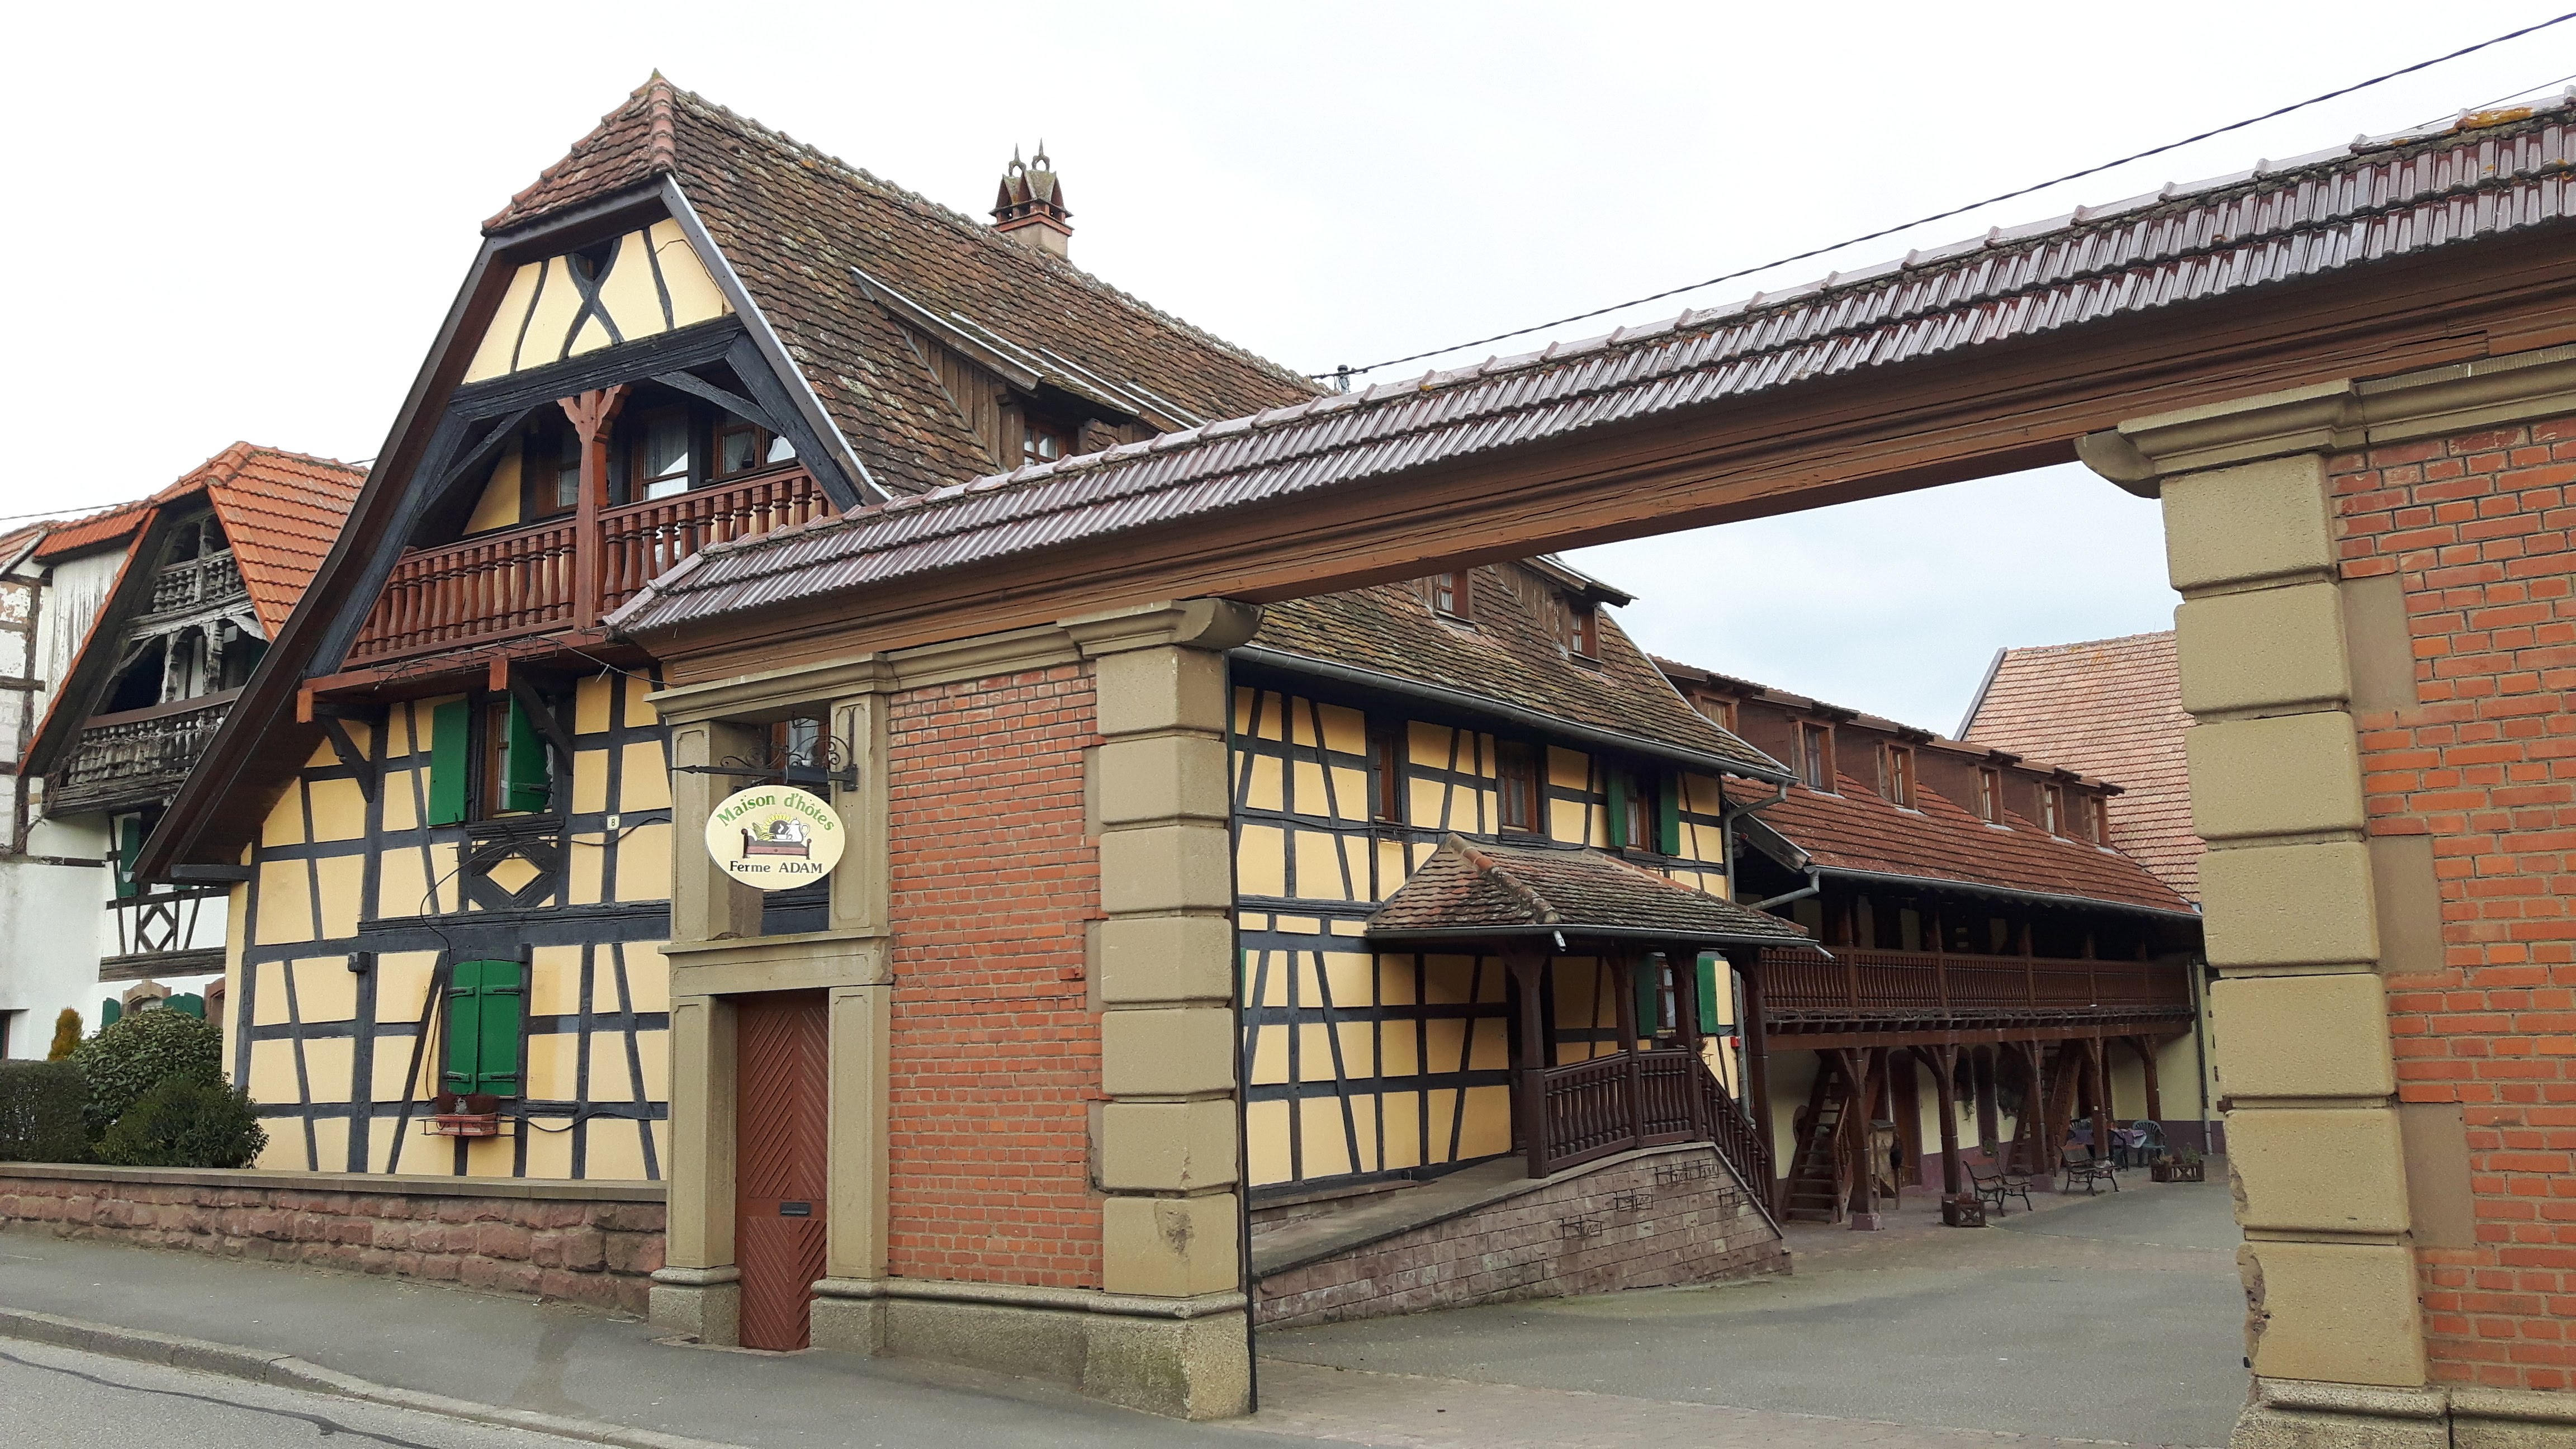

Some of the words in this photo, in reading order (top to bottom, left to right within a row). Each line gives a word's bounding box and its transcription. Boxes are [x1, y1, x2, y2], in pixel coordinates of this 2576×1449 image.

[716, 795, 776, 827] Maison
[784, 793, 834, 831] d'hôtes
[730, 860, 771, 873] Ferme
[778, 862, 823, 874] ADAM
